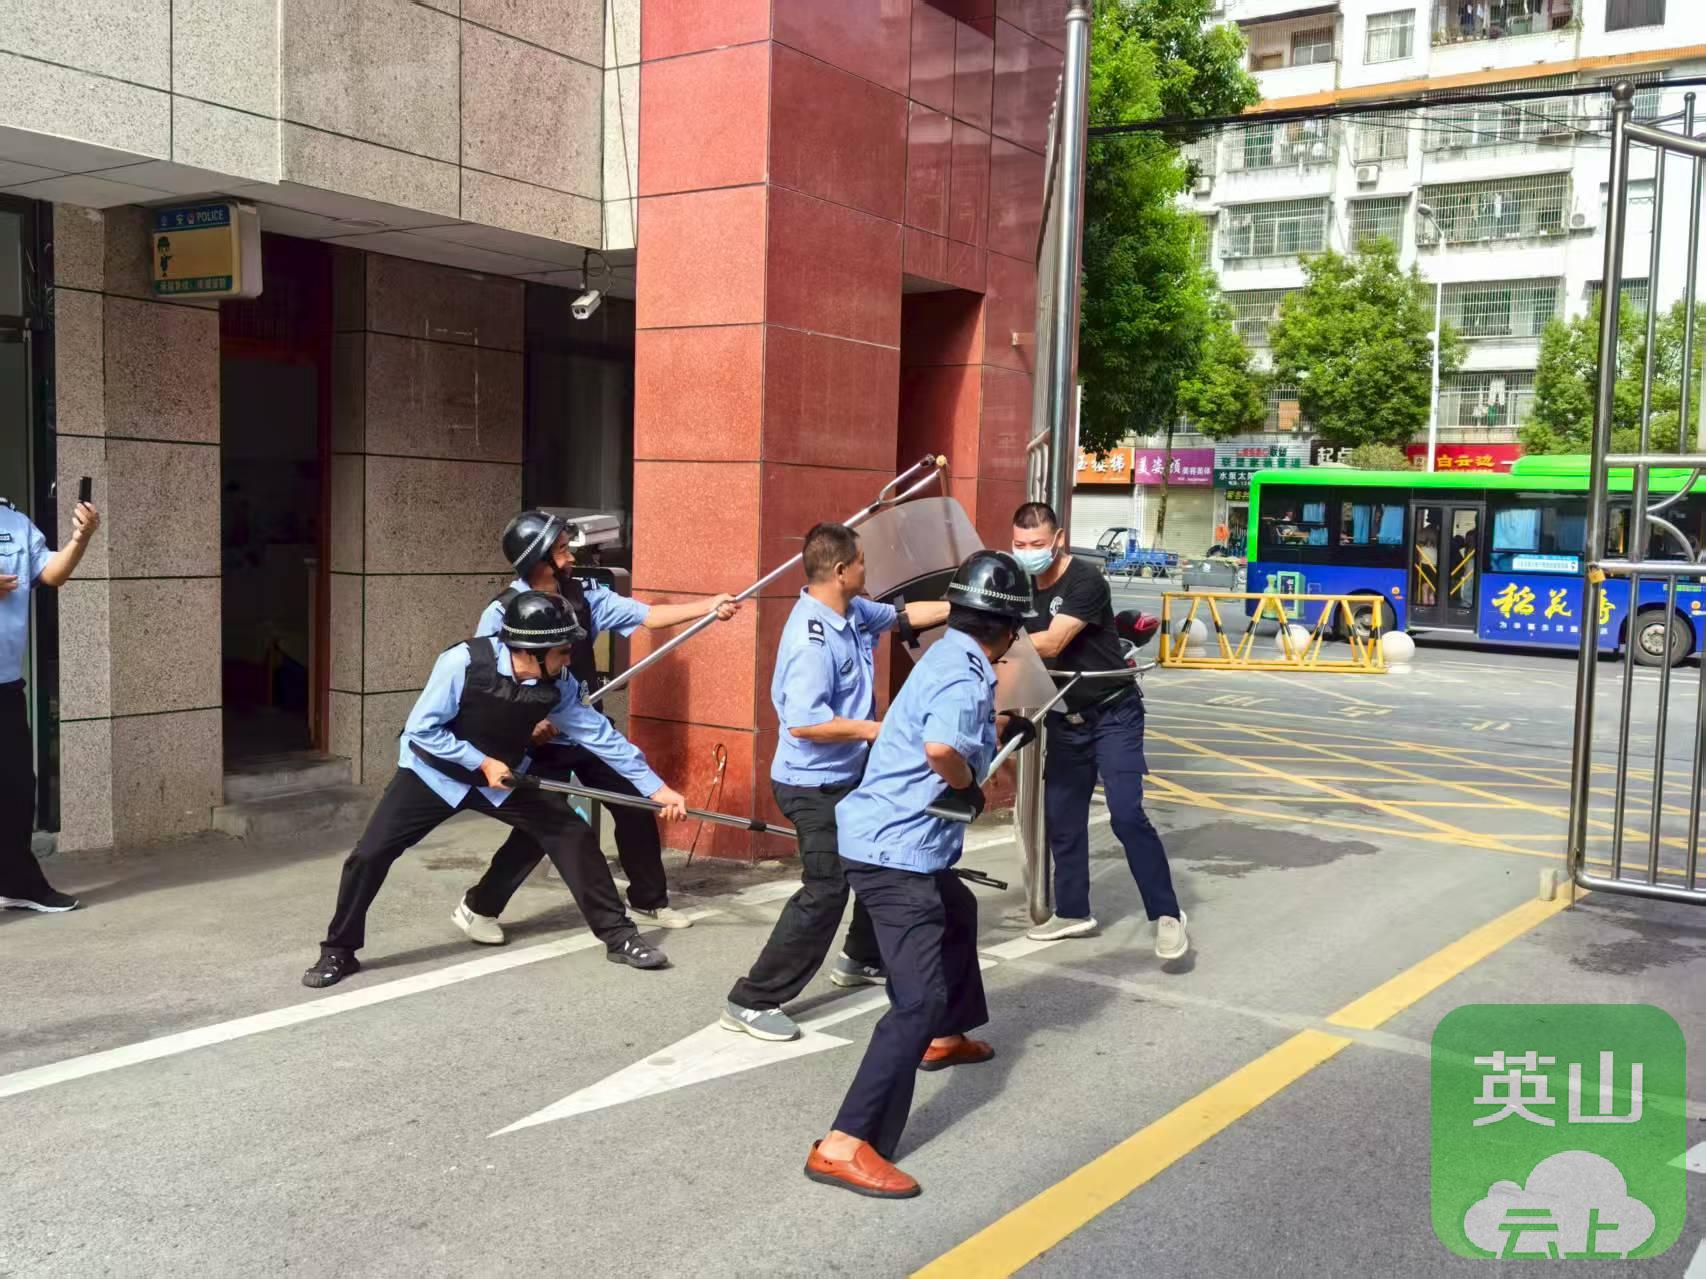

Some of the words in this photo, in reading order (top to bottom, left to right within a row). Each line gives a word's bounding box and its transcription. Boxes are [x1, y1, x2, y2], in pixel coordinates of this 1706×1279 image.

[196, 209, 225, 222] POLICE
[1437, 454, 1496, 468] 白云边
